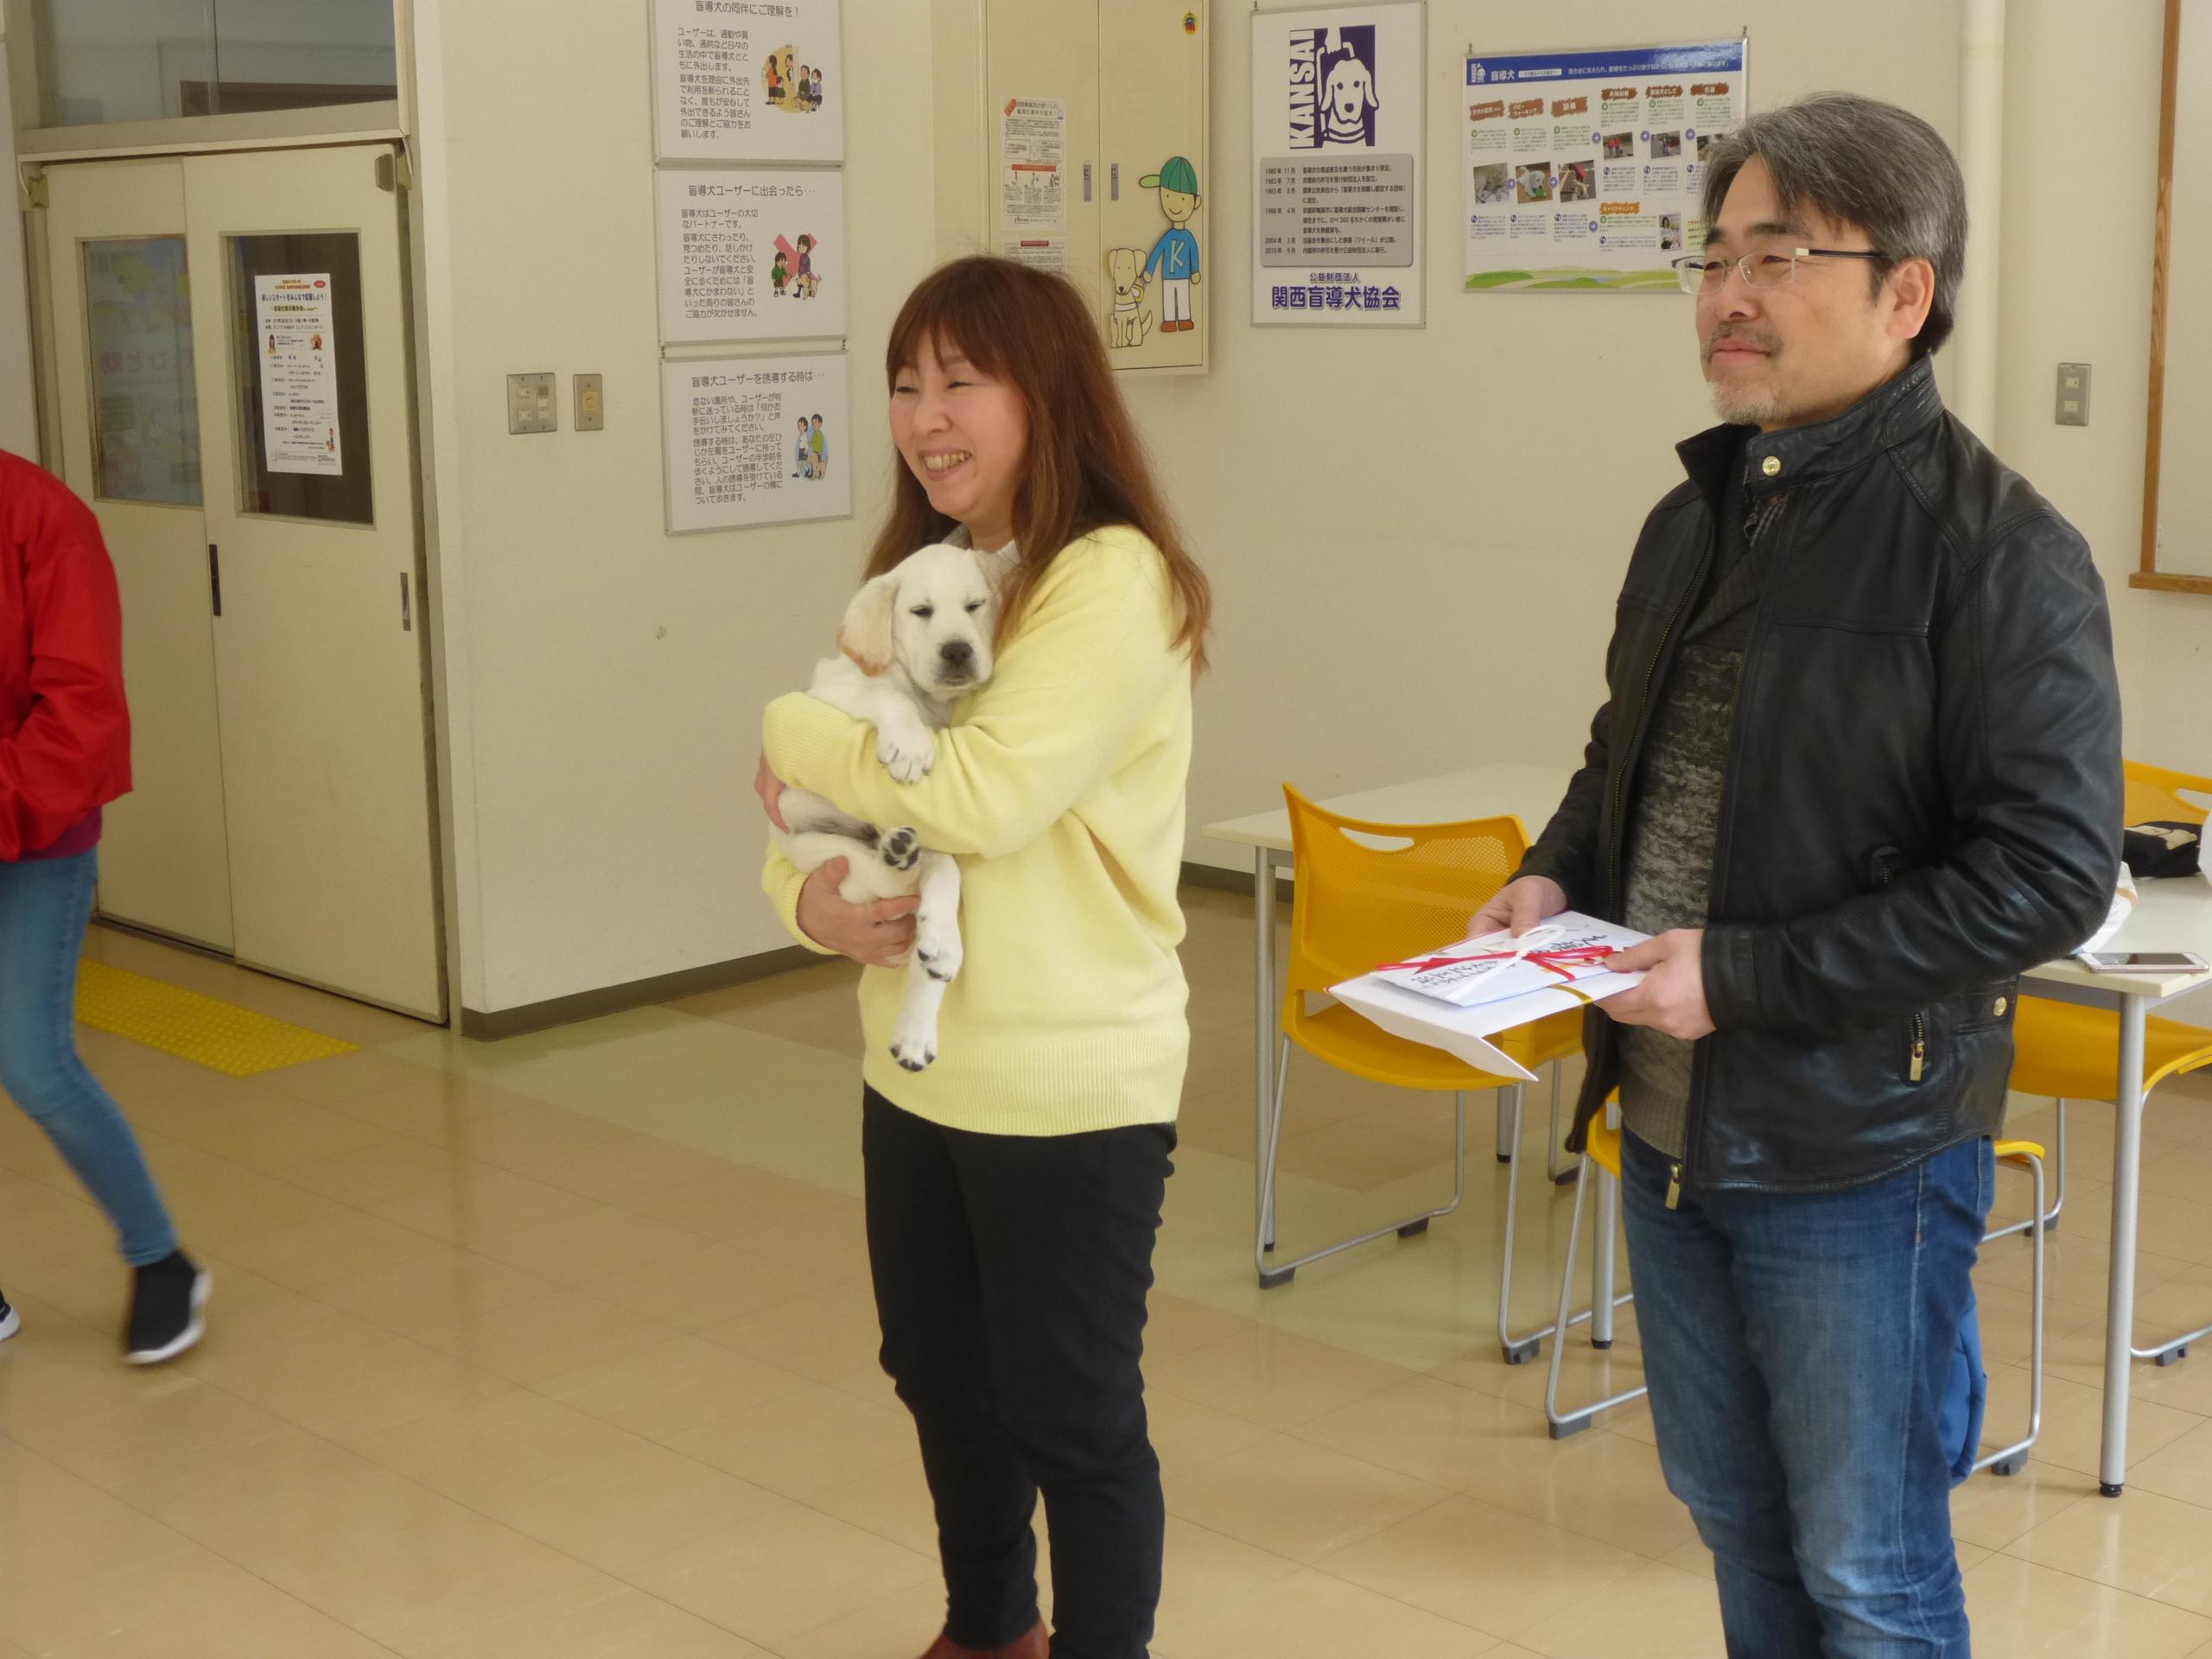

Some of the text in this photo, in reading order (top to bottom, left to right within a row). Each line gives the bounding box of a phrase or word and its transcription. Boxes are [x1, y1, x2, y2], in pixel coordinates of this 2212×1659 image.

[696, 1, 798, 17] 盲導犬の同伴にご理解を！
[679, 60, 732, 73] もに外出します。
[1290, 29, 1314, 148] KANSAI
[682, 219, 742, 229] なパートナーです。
[683, 232, 750, 243] 盲導犬にさわったり、
[683, 254, 757, 264] たりしないでください。
[1169, 238, 1187, 274] K
[1309, 272, 1360, 283] 公益財団法人
[1272, 286, 1400, 309] 関西盲導犬協会
